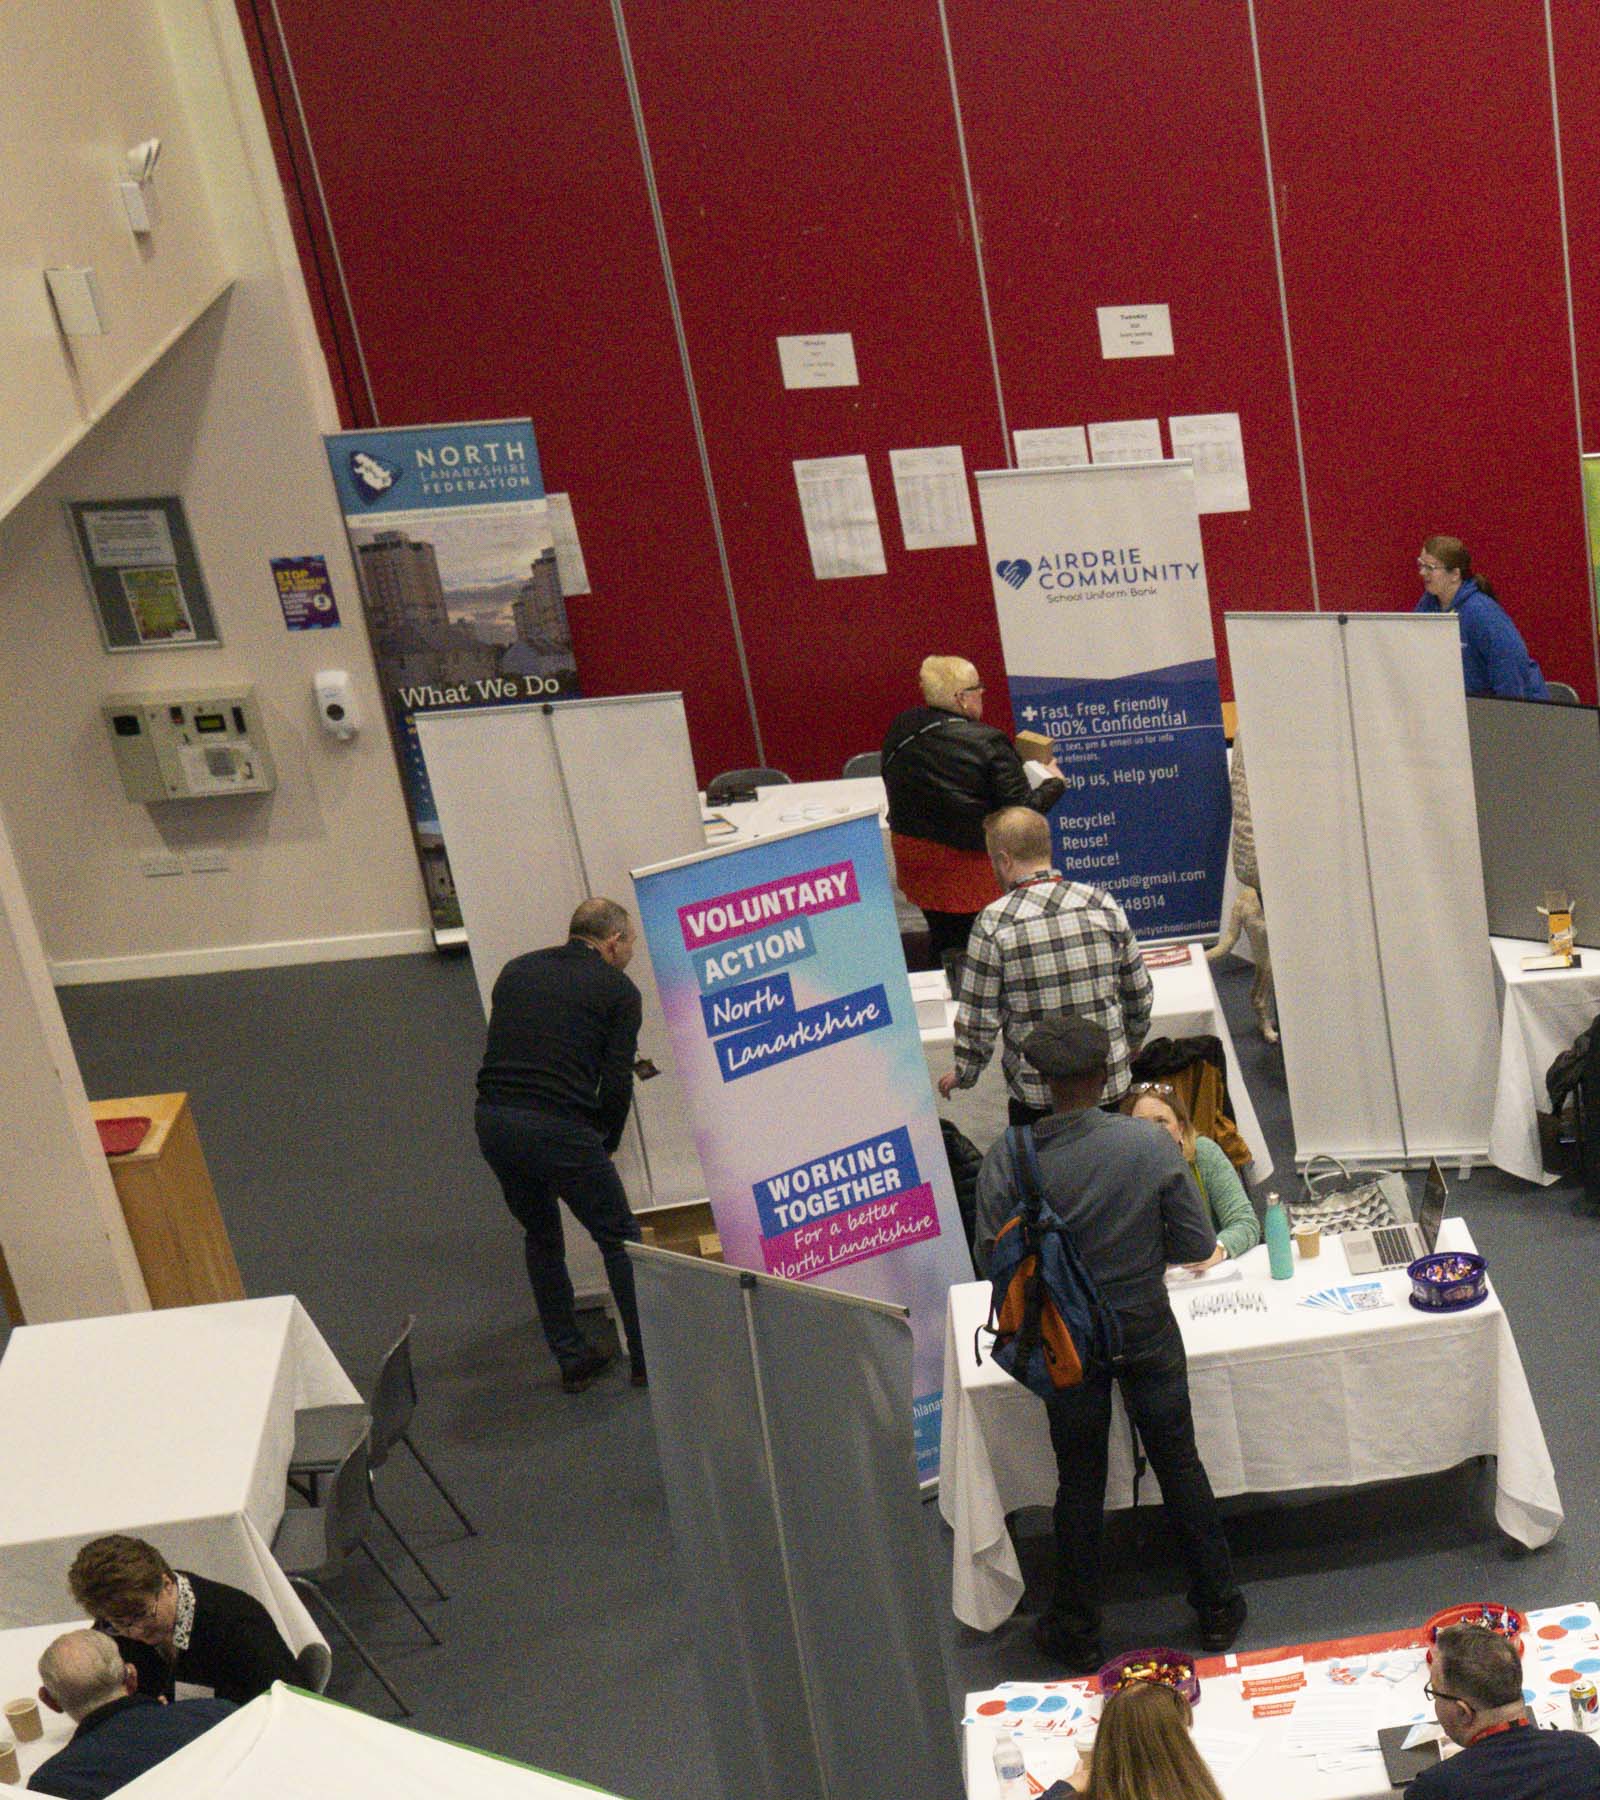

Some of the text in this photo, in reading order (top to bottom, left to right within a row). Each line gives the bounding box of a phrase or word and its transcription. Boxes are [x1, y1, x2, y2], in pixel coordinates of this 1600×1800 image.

[415, 441, 526, 468] NORTH
[420, 463, 528, 482] LANARKSHIRE
[422, 476, 531, 495] FEDERATION
[1038, 548, 1142, 572] AIRDRIE
[1039, 563, 1200, 590] COMMUNITY
[1046, 586, 1158, 605] School Uniform Bank
[399, 674, 560, 708] What We Do
[1041, 695, 1170, 721] Fast, Free, Friendly
[1042, 709, 1189, 738] 100% Confidential
[1065, 763, 1181, 790] elp us, Help you!
[1059, 812, 1117, 832] Recycle!
[1063, 833, 1109, 850] Reuse!
[1065, 852, 1121, 870] Reduce!
[685, 871, 849, 940] VOLUNTARY
[705, 926, 807, 985] ACTION
[712, 984, 786, 1027] North
[727, 1003, 881, 1073] Lanarkshire
[766, 1140, 898, 1202] WORKING
[773, 1166, 903, 1229] TOGETHER
[793, 1199, 901, 1253] For a better
[771, 1213, 935, 1280] North Lanarkshire
